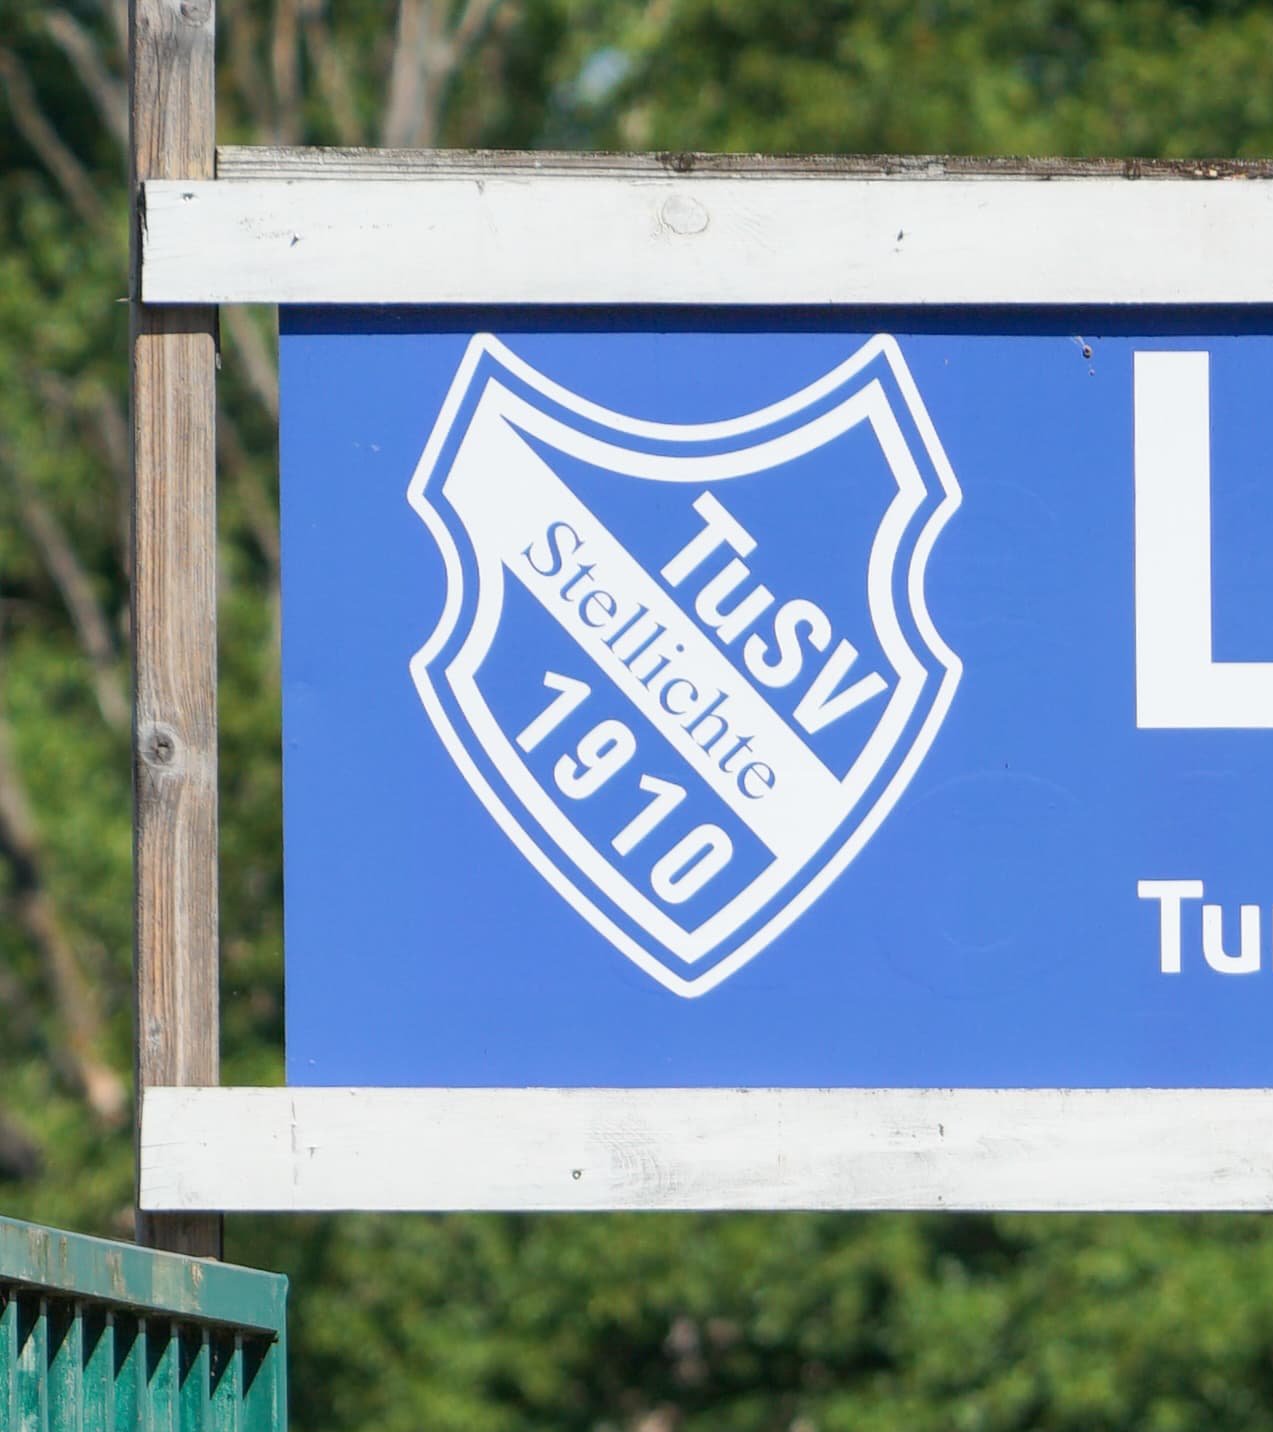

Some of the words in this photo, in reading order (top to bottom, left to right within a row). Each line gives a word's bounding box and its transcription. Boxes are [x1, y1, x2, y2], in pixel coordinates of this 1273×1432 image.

[521, 521, 776, 800] Stellichte
[660, 491, 888, 734] TuSV
[516, 672, 733, 904] 1910
